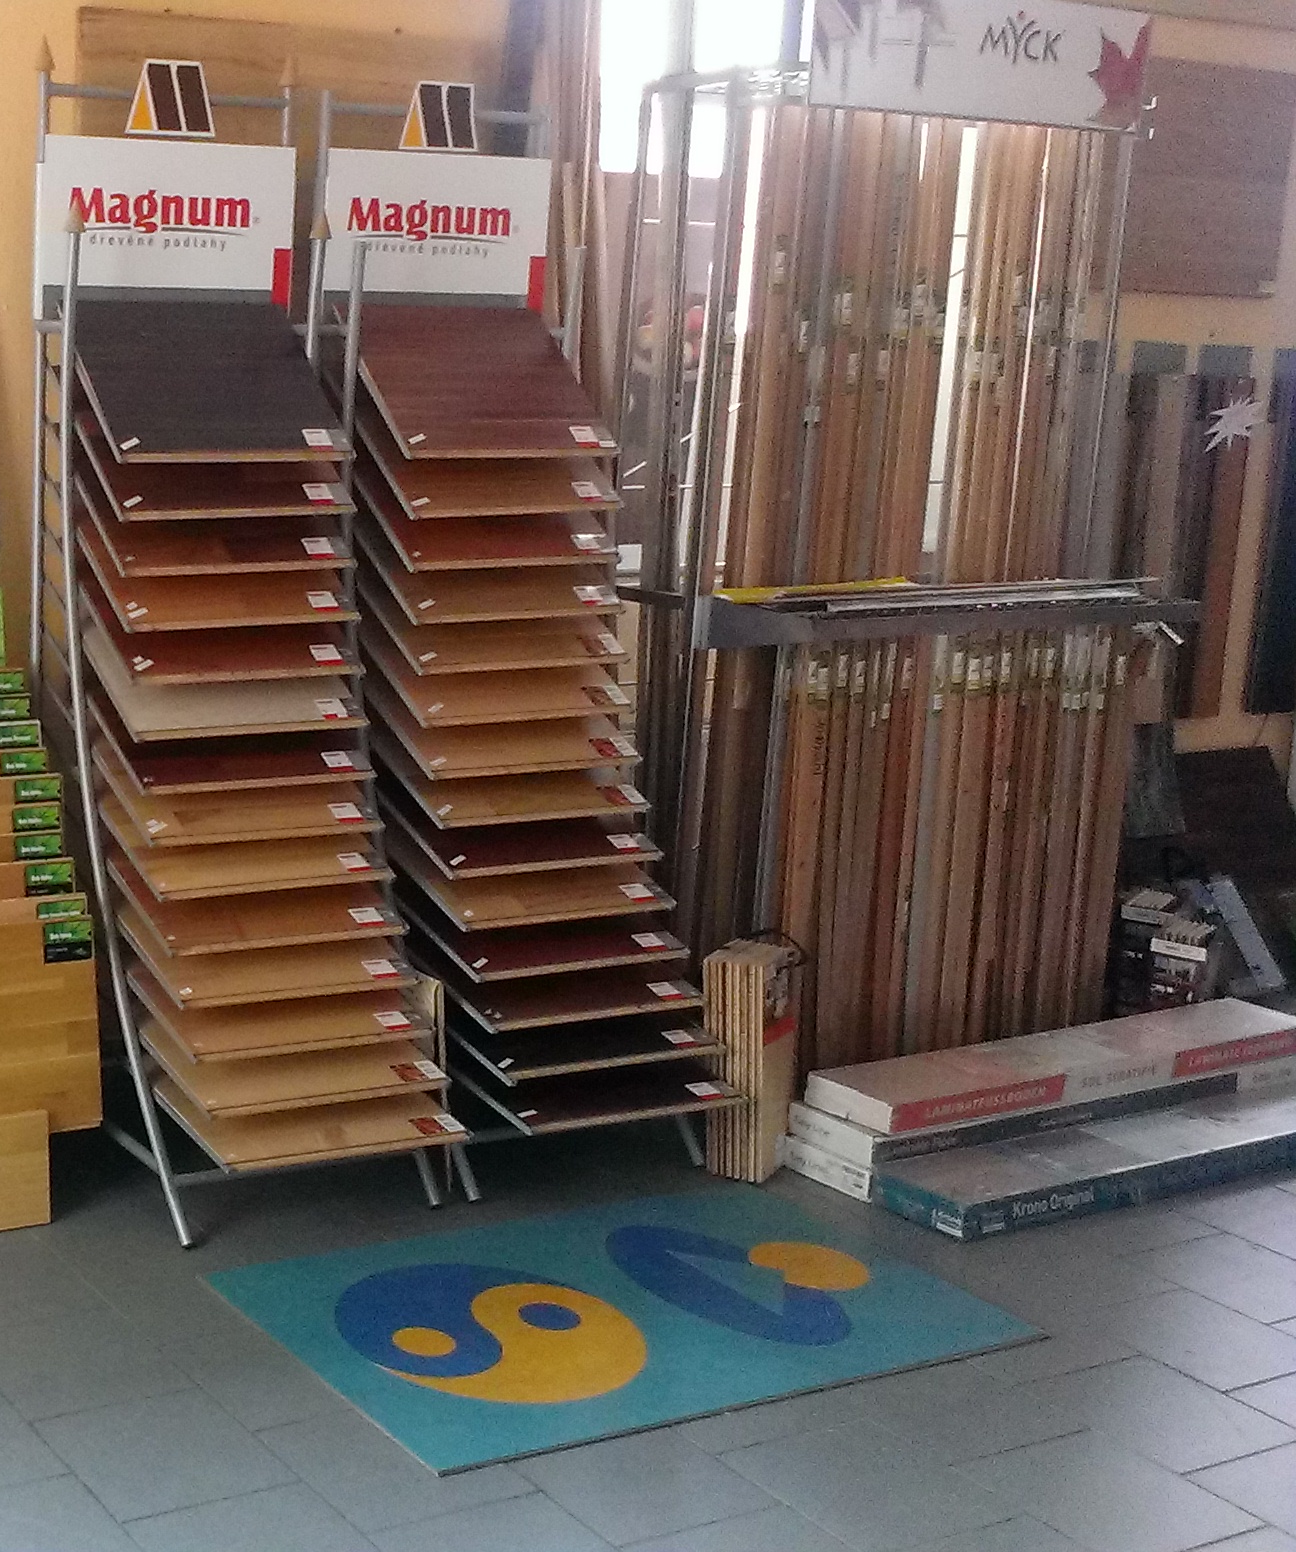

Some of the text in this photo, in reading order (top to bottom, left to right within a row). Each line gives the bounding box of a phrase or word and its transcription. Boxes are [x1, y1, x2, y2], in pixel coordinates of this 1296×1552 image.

[69, 186, 252, 234] Magnum
[347, 196, 512, 242] Magnum
[1012, 1199, 1050, 1220] Krono
